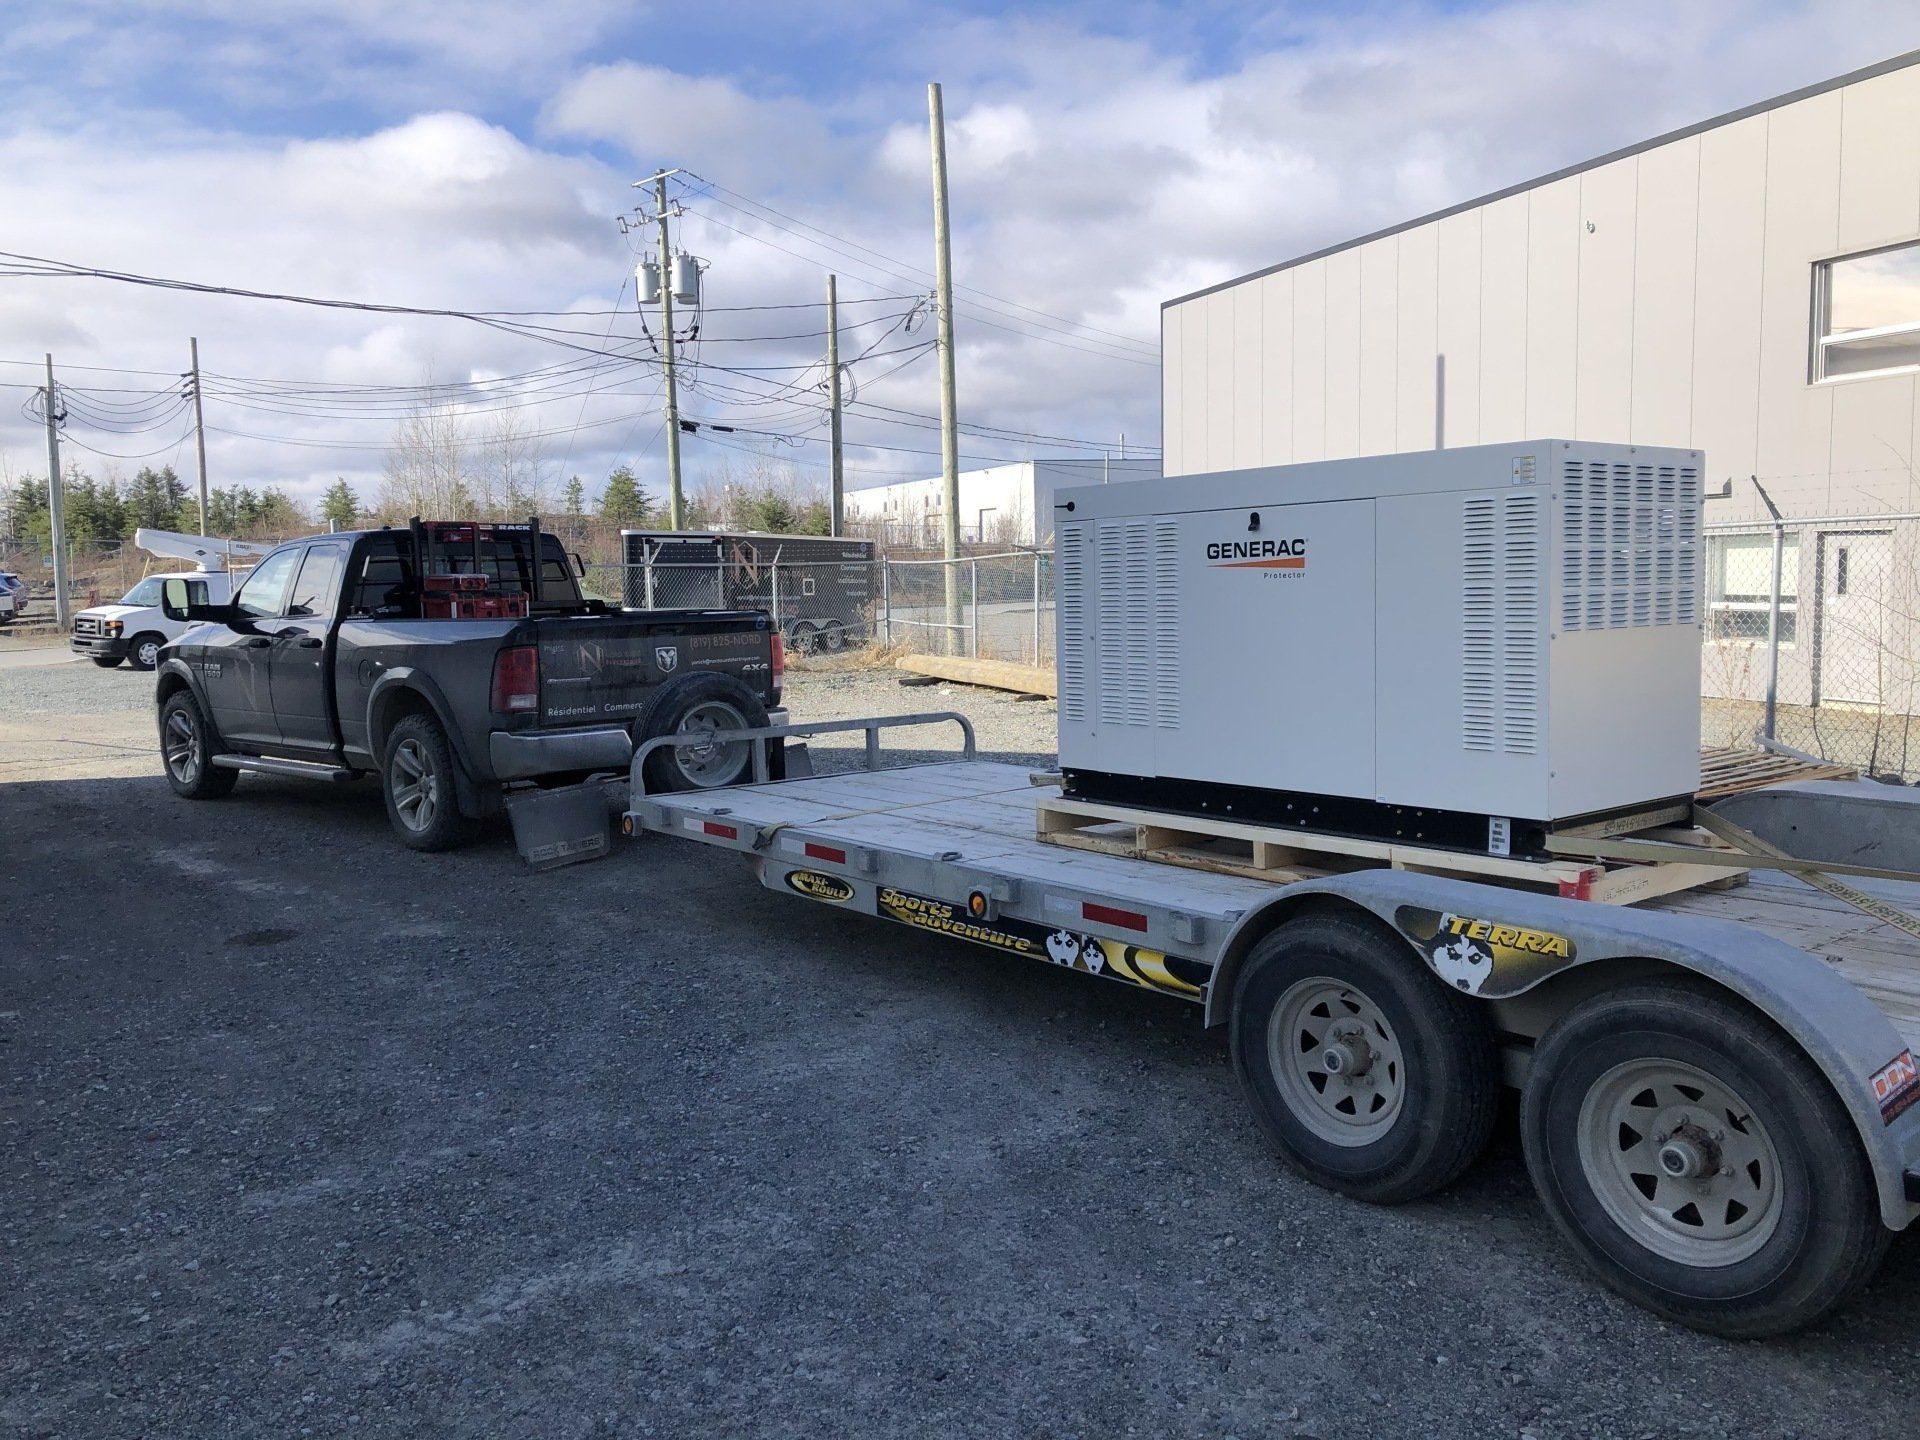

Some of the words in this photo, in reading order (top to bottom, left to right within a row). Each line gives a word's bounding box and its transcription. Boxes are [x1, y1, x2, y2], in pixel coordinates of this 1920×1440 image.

[1207, 539, 1305, 559] GENERAC
[689, 636, 711, 650] (819)
[713, 634, 761, 646] 825-NORD
[204, 670, 221, 678] 1500
[548, 705, 596, 716] Résidentiel
[604, 701, 646, 712] Commerc
[811, 884, 847, 899] ROULE
[879, 888, 952, 918] Sports
[914, 911, 1031, 950] adventure
[1449, 917, 1569, 957] TERRA
